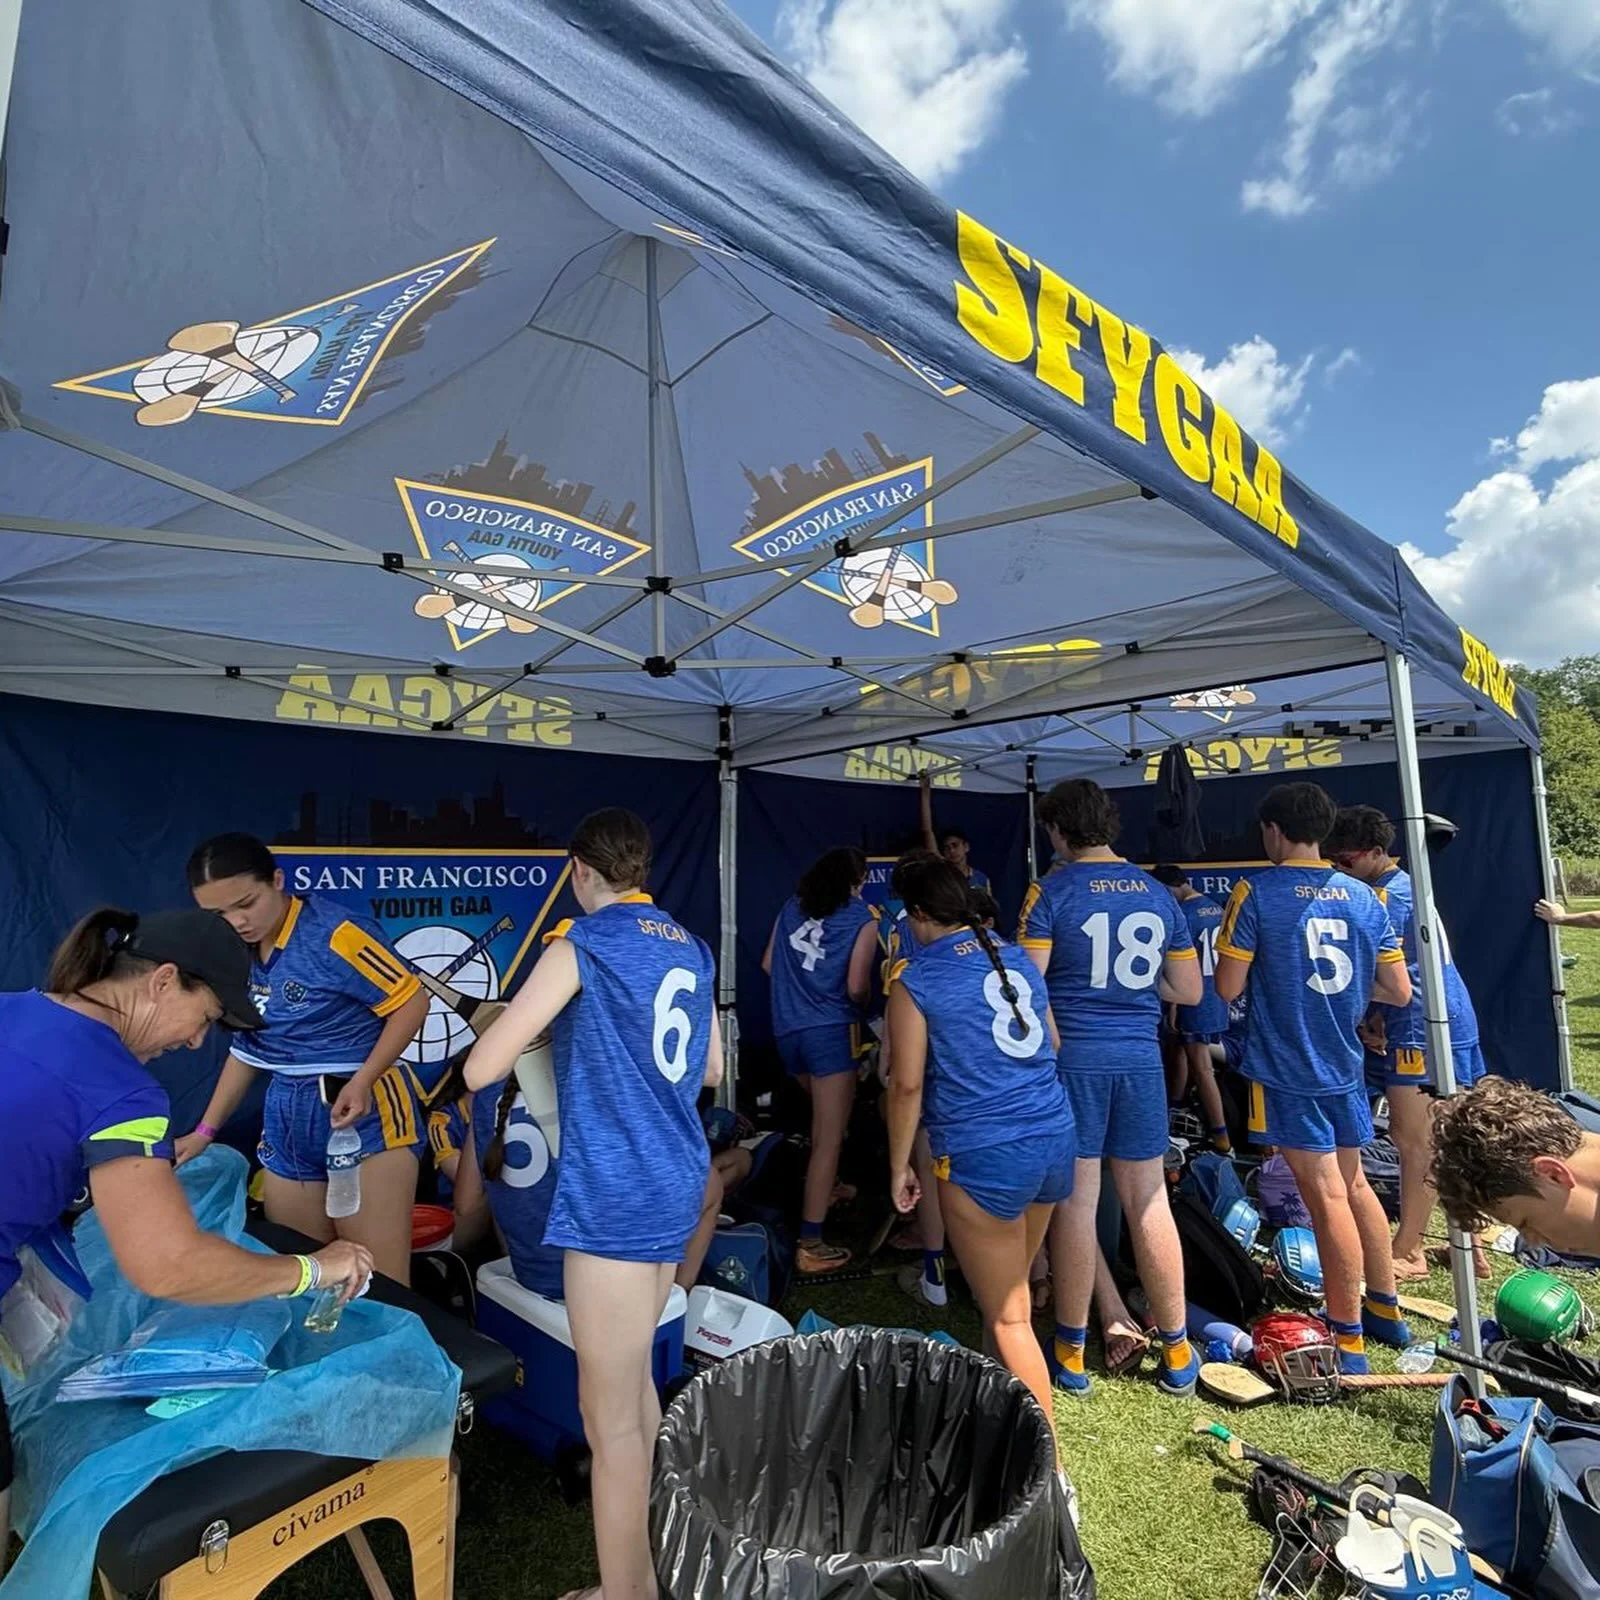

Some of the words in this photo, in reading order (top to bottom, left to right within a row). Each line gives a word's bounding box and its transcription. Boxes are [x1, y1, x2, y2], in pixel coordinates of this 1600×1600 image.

[954, 209, 1299, 549] SFYGAA
[294, 866, 366, 891] SAN
[376, 865, 548, 890] FRANCISCO
[370, 896, 443, 919] YOUTH
[450, 895, 493, 916] GAA
[1089, 879, 1150, 893] SFYGAA
[1294, 885, 1351, 901] SFYGAA
[789, 915, 827, 973] 4
[1080, 911, 1166, 990] 18
[1305, 917, 1354, 996] 5
[652, 967, 698, 1084] 6
[983, 968, 1044, 1059] 8
[272, 1482, 365, 1547] civama
